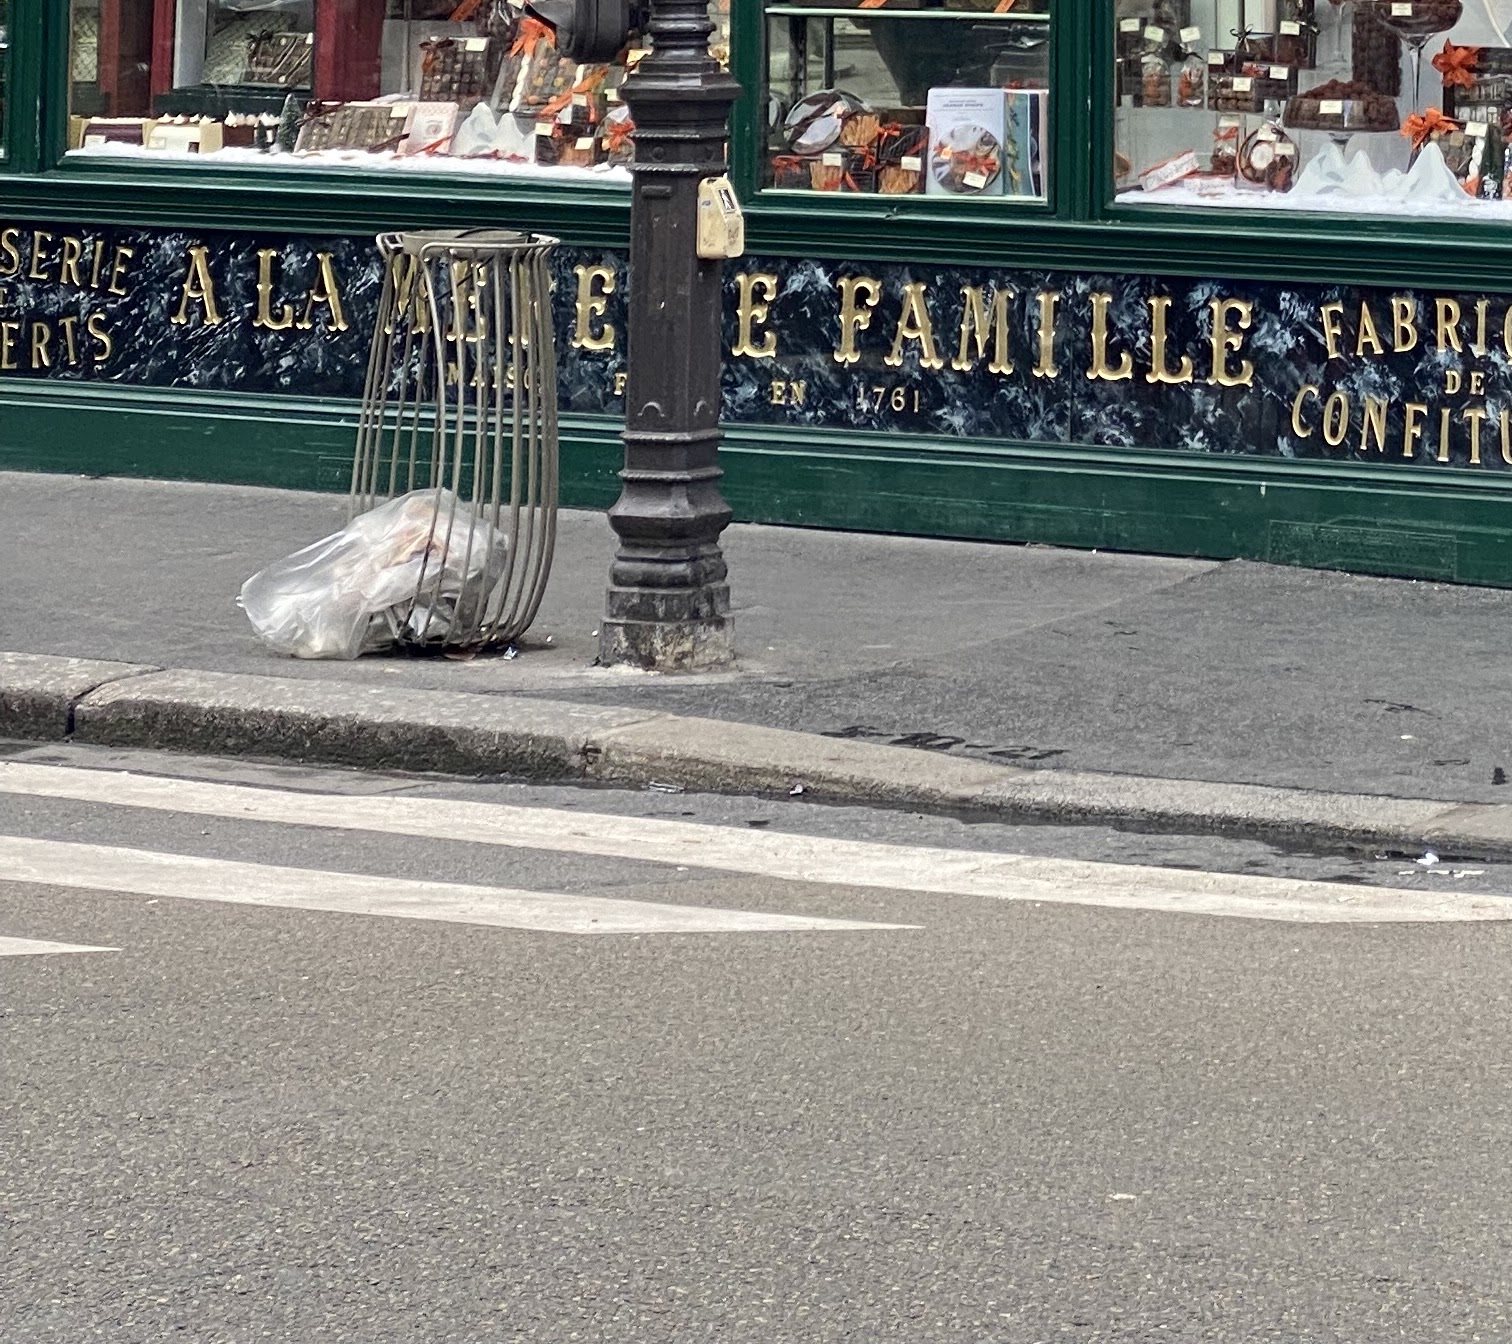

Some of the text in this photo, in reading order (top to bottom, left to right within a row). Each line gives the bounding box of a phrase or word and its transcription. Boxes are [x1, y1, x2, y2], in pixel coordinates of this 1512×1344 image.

[0, 227, 135, 296] SERIE
[0, 311, 112, 370] ERTS
[171, 245, 224, 326] A
[253, 248, 349, 333] LA
[732, 271, 778, 360] E
[834, 274, 1254, 389] FAMILLE
[769, 381, 807, 406] EN
[856, 385, 921, 414] 1761
[1445, 370, 1486, 396] DE
